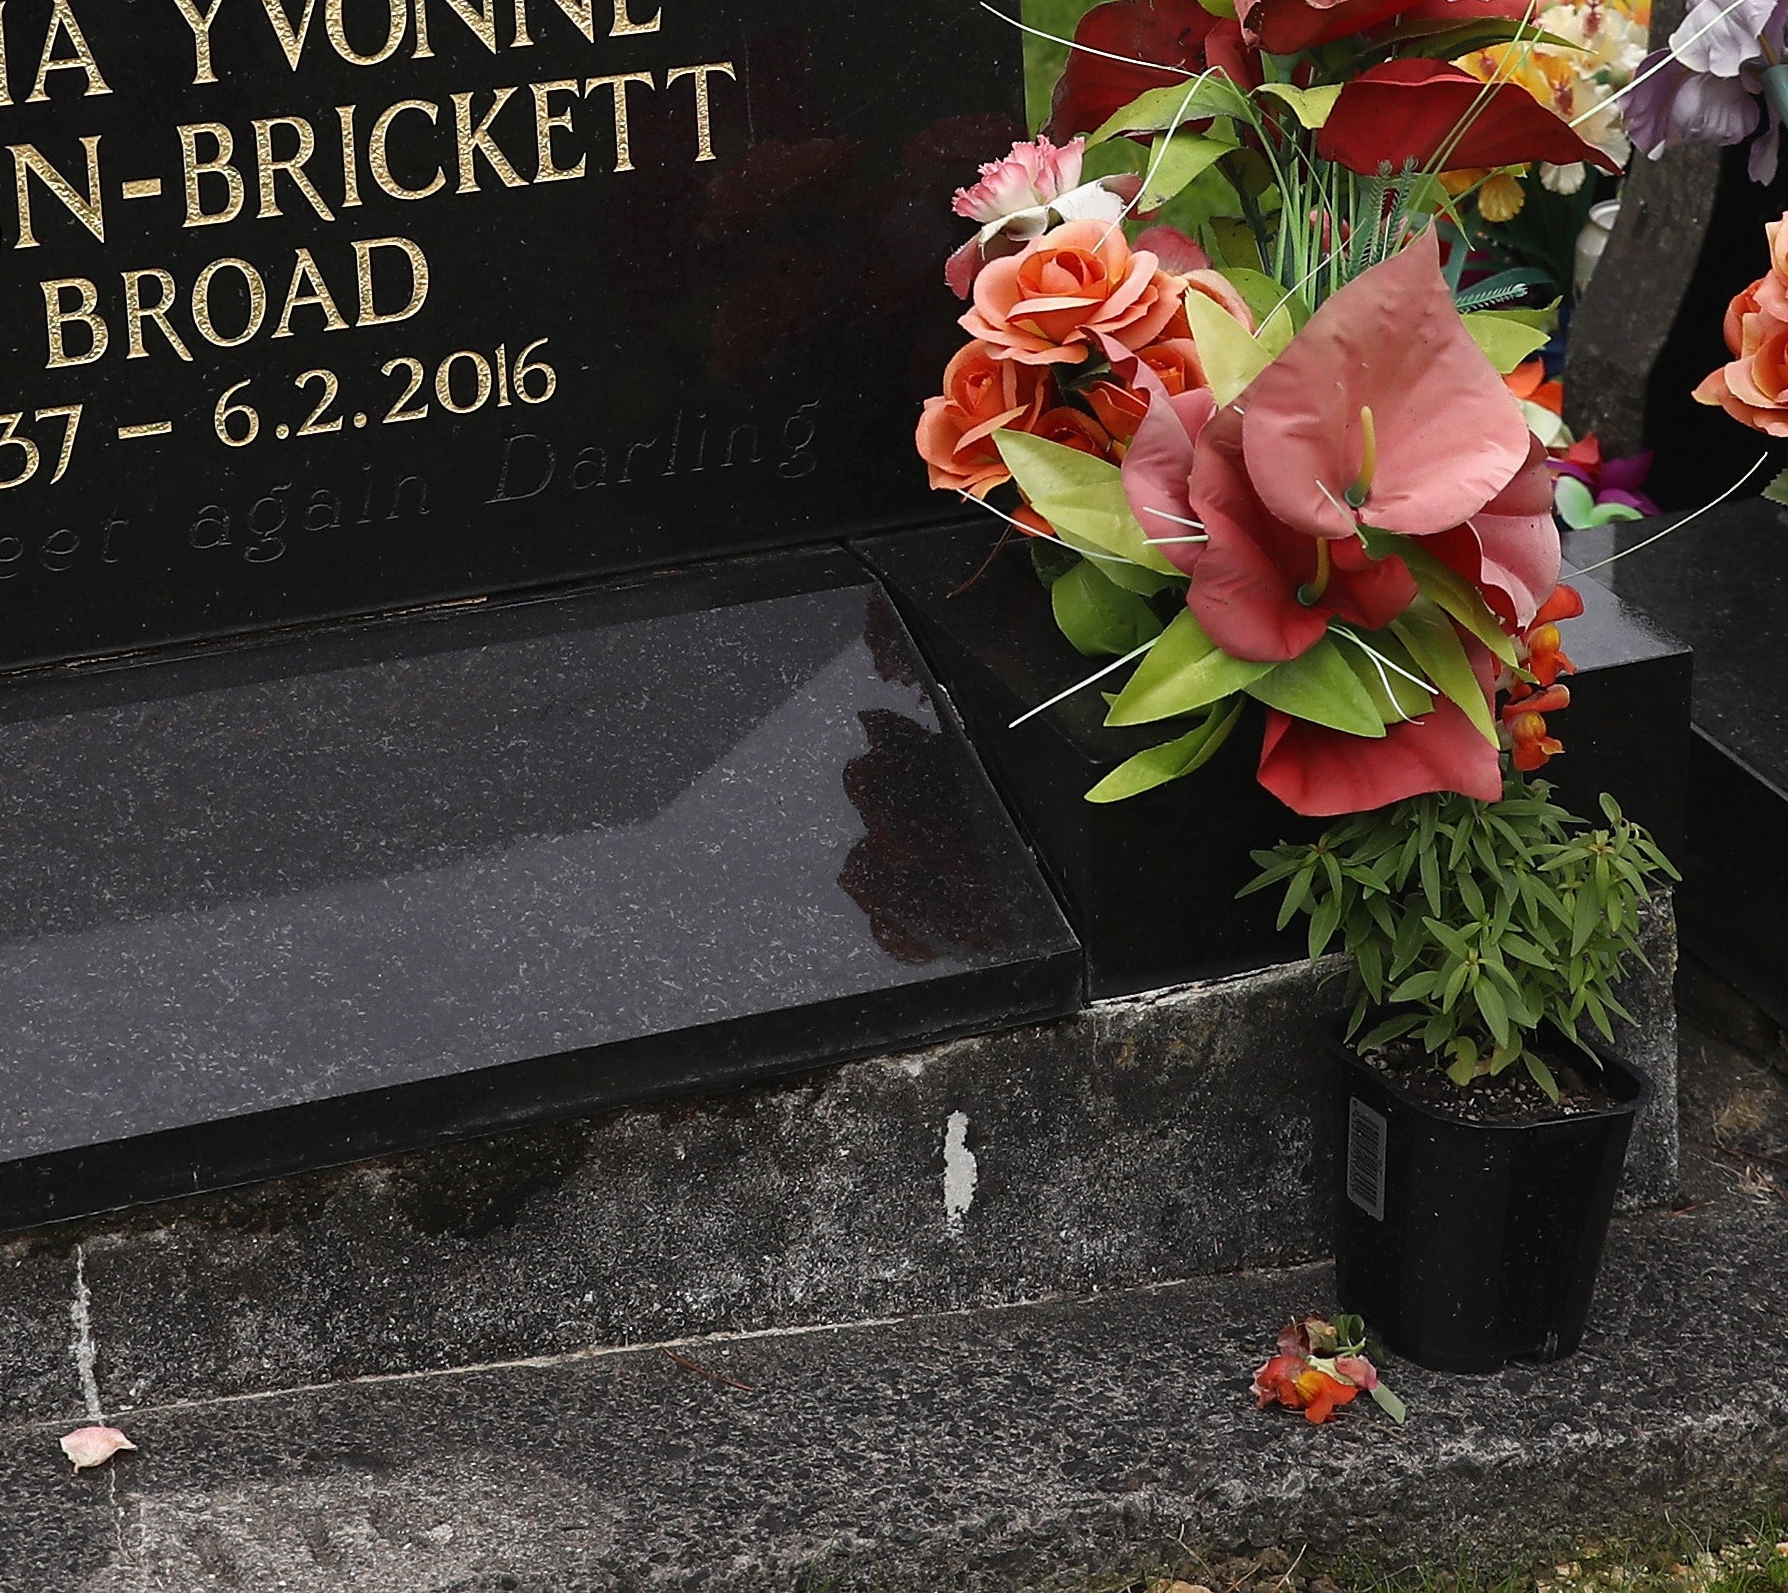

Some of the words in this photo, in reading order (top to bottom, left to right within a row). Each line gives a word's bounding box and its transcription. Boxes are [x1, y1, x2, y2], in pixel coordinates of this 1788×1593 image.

[42, 235, 428, 373] BROAD
[214, 336, 558, 448] 6.2.2016
[187, 463, 434, 564] again
[484, 399, 820, 506] Darling
